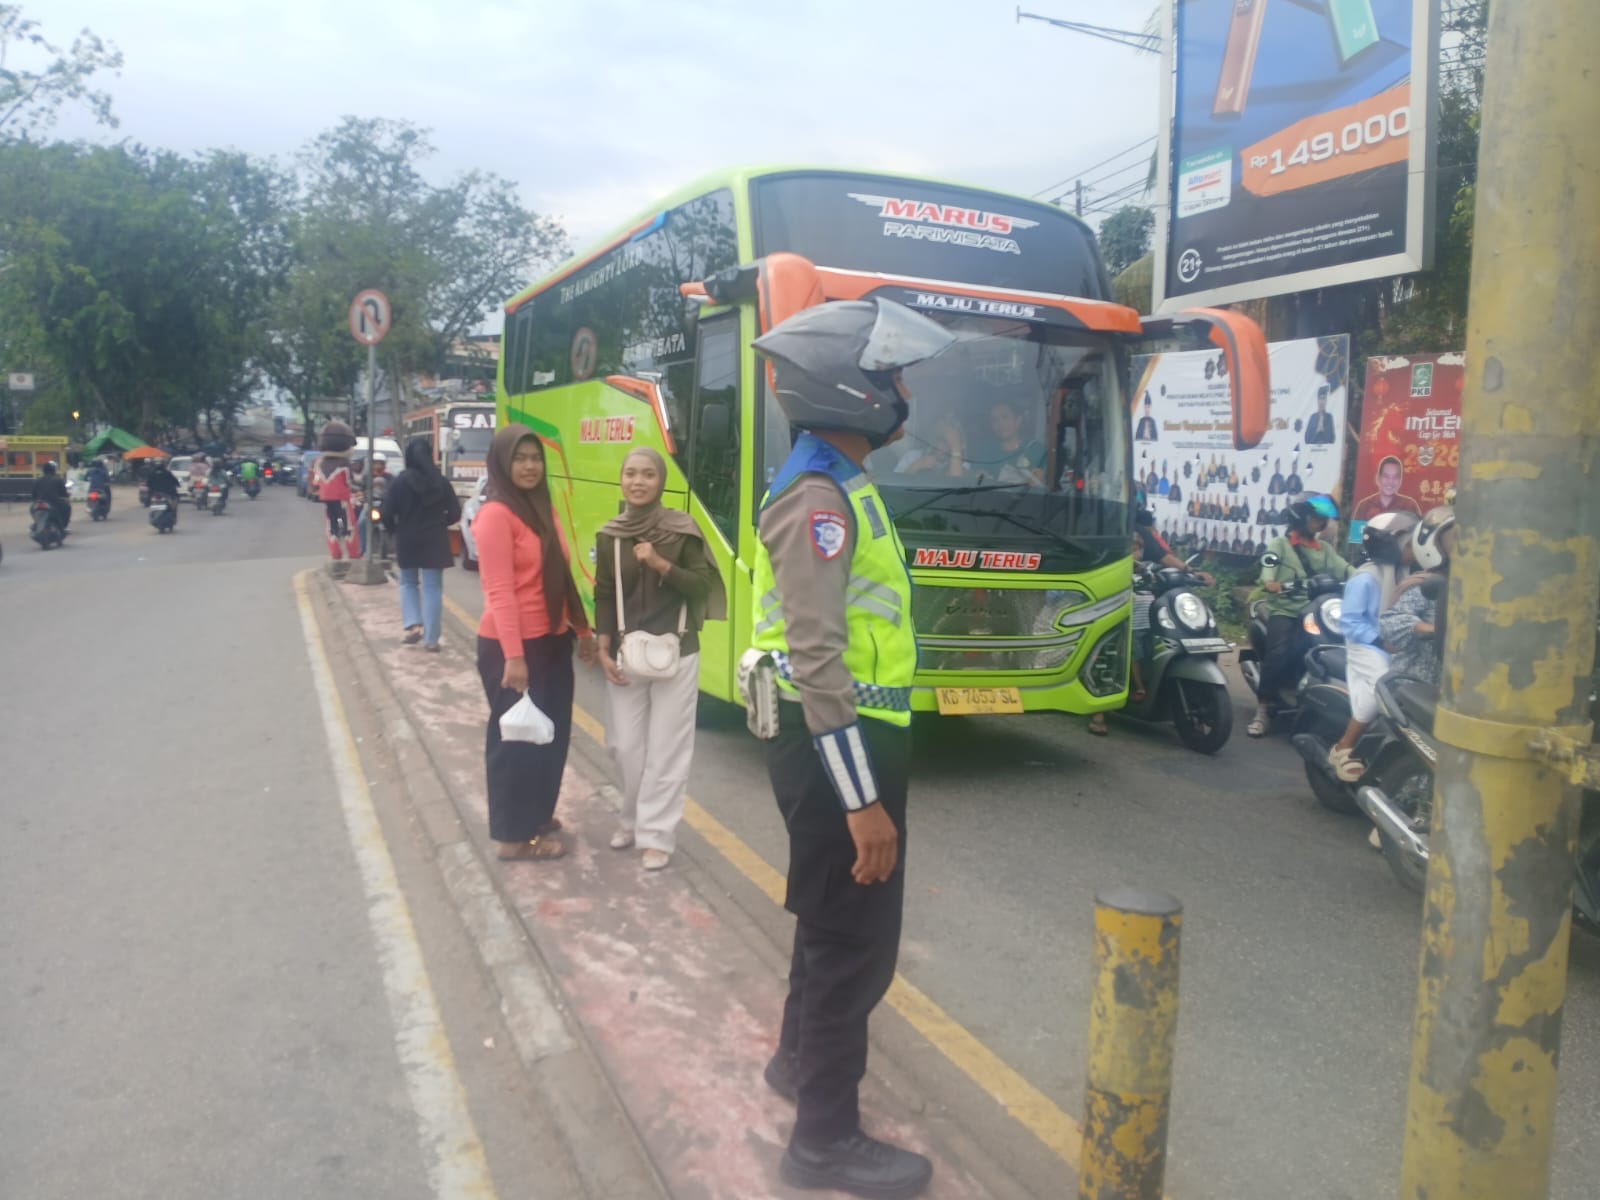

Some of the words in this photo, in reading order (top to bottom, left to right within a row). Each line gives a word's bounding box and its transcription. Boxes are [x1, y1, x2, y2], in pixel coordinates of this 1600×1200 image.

[1250, 155, 1267, 169] Rp
[1269, 106, 1410, 175] 149.000
[880, 198, 1014, 235] MARUS
[883, 221, 1021, 255] PARIWISATA
[1182, 256, 1203, 273] 21+
[916, 294, 972, 312] MAJU
[977, 300, 1036, 318] TERUS
[579, 417, 601, 443] MAJU
[604, 415, 635, 442] TERUS
[913, 547, 978, 569] MAJU
[980, 551, 1042, 571] TERUS
